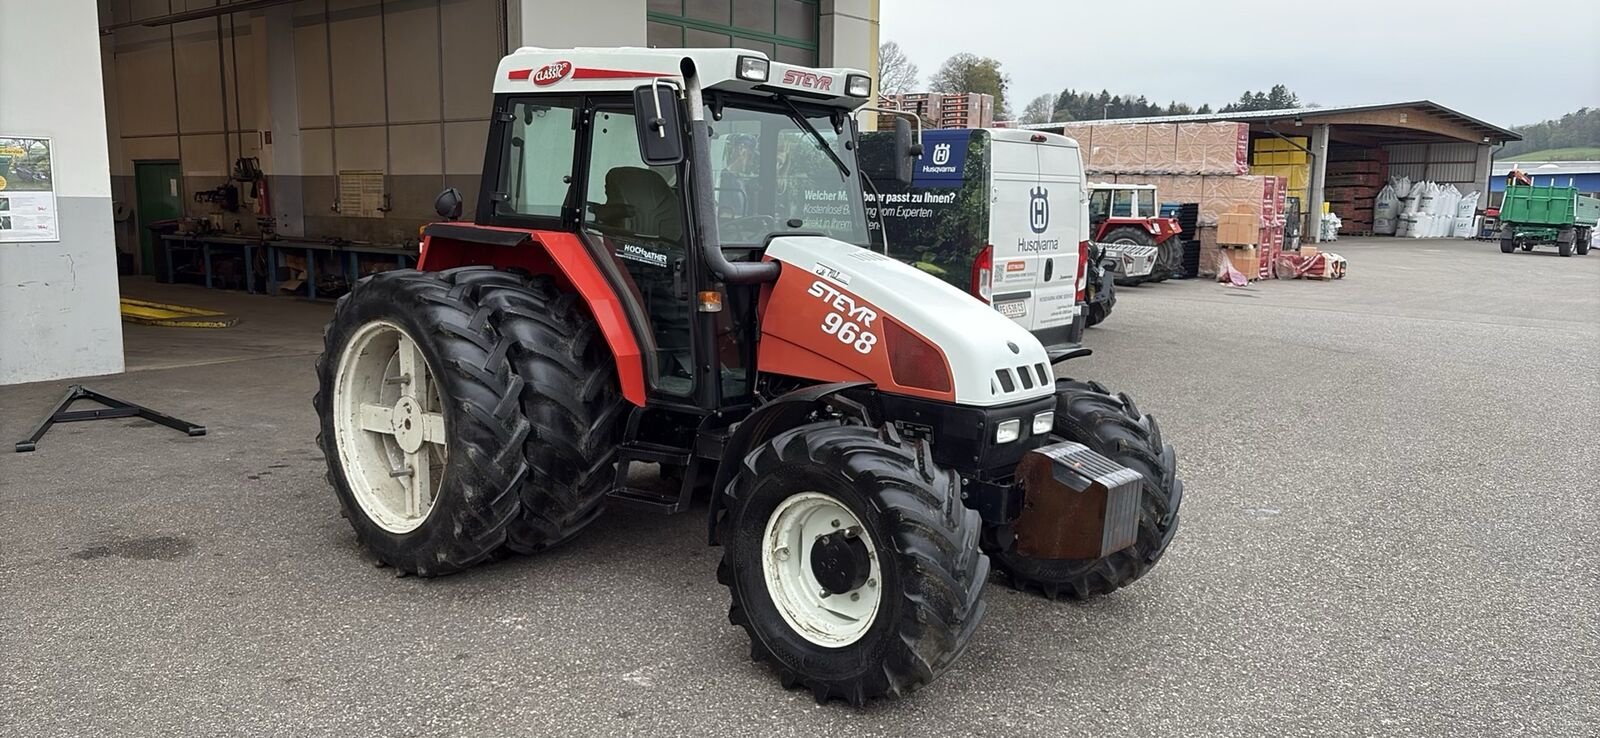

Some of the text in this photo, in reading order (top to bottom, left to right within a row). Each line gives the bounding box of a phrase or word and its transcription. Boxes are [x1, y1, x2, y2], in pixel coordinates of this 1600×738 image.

[535, 66, 564, 81] CLASSIC
[783, 70, 832, 90] STEYR
[922, 165, 956, 173] Husqvarna
[804, 190, 836, 201] Welcher
[886, 192, 910, 204] passt
[911, 194, 922, 203] zu
[924, 192, 956, 204] Ihnen?
[896, 206, 933, 219] Experten
[624, 244, 667, 264] HOCHRATHER
[1018, 238, 1059, 254] Husqvarna
[807, 280, 878, 329] STEYR
[820, 312, 878, 354] 968
